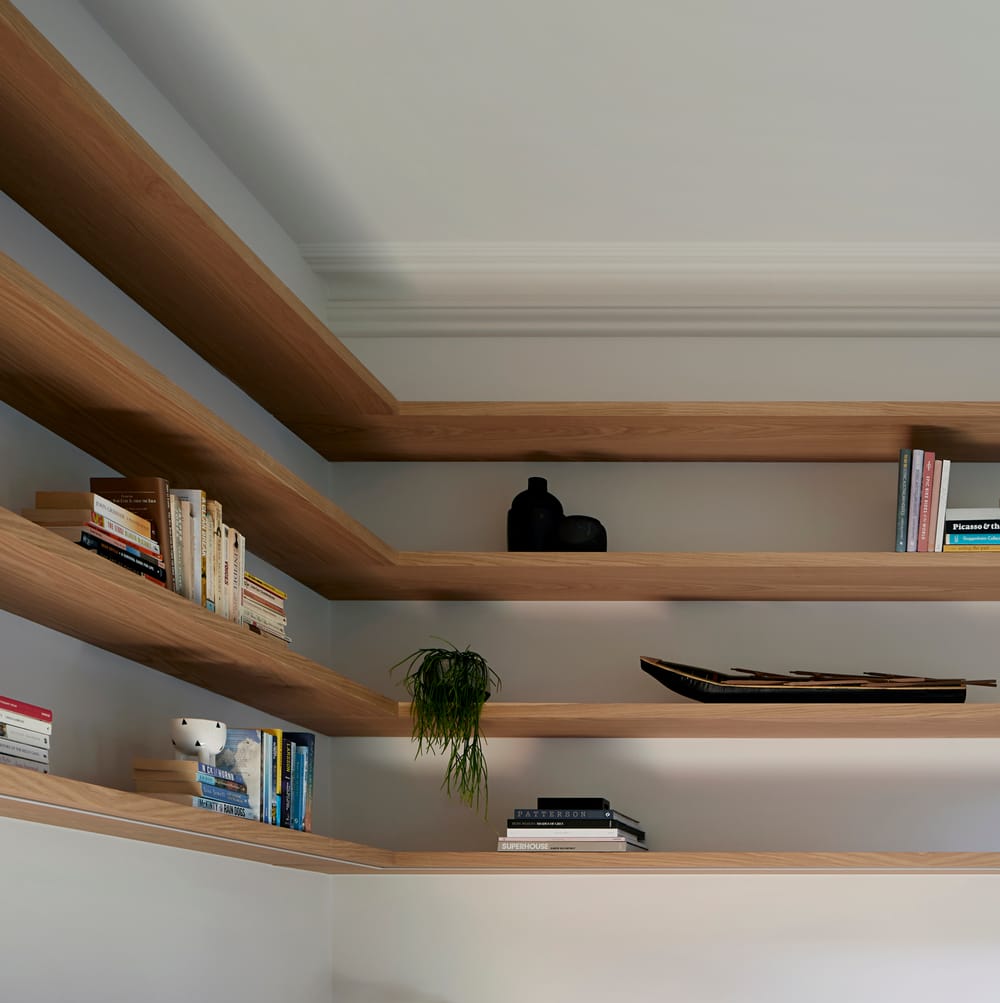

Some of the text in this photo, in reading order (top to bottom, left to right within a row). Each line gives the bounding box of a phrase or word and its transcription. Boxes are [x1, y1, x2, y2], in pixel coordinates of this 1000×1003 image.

[952, 523, 983, 531] Picasso
[517, 810, 587, 818] PATTERSON
[502, 842, 549, 850] SUPERHOUSE
